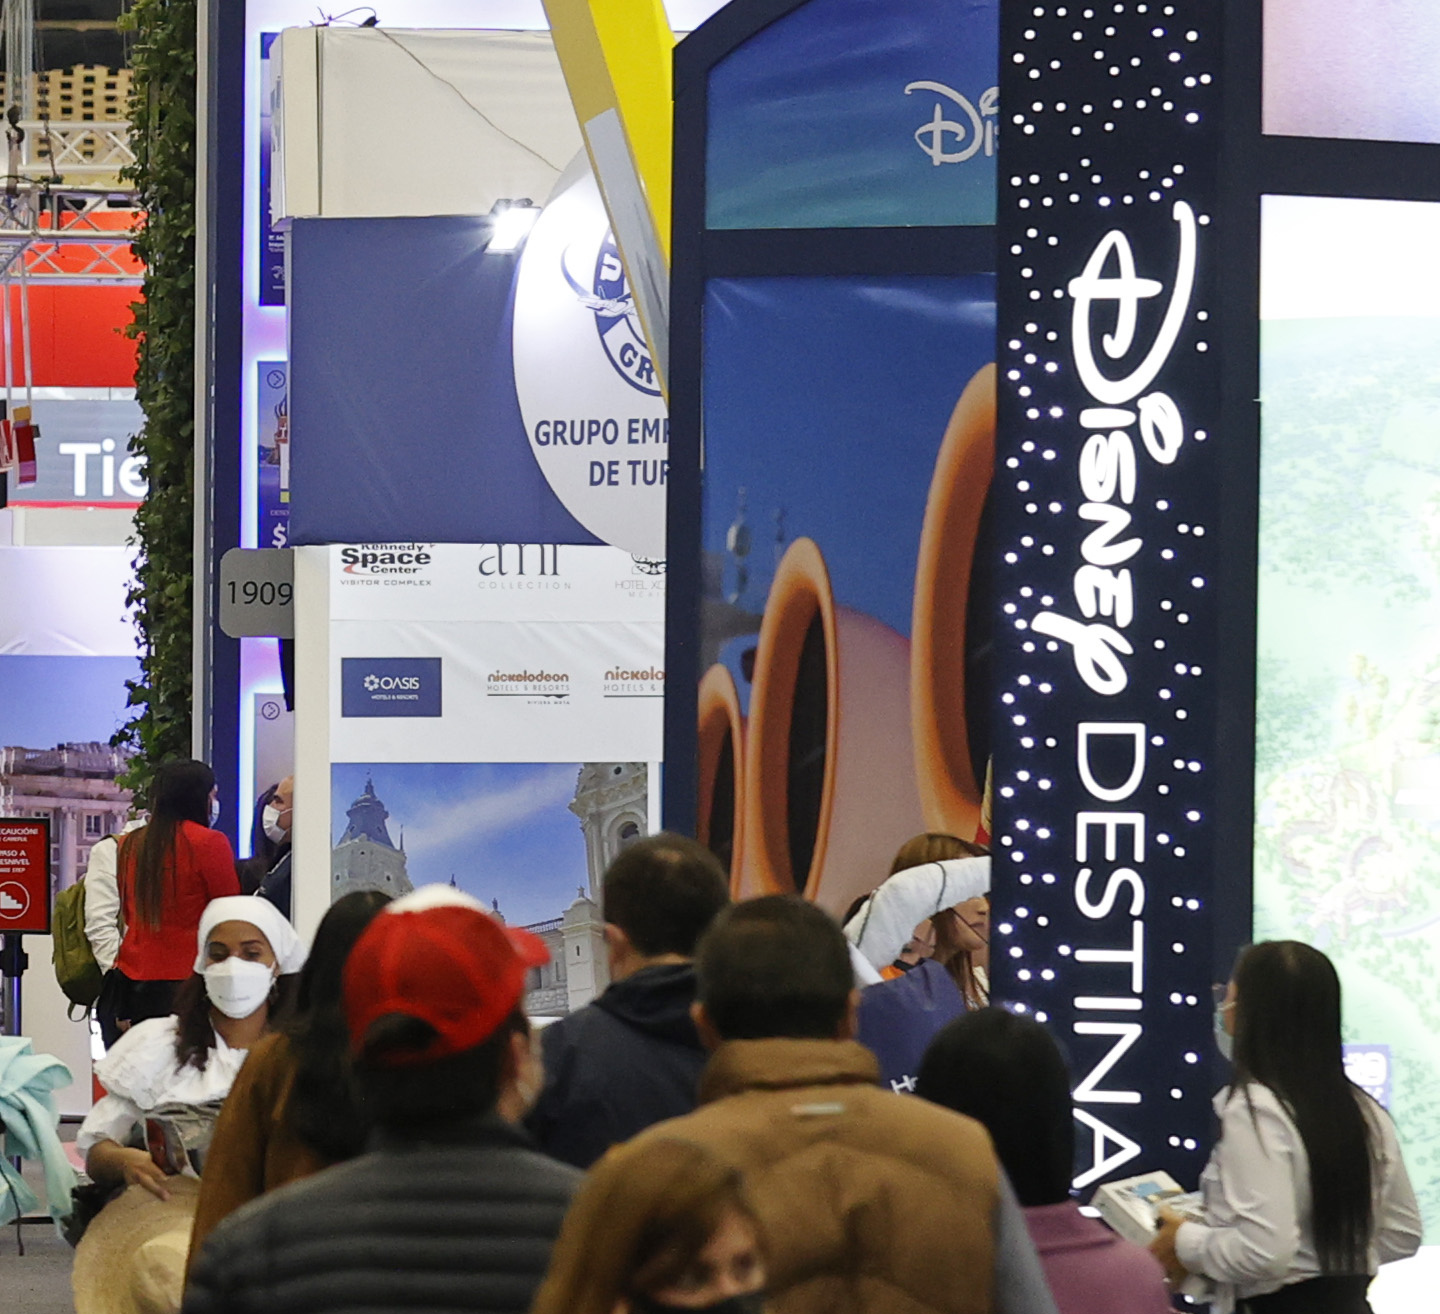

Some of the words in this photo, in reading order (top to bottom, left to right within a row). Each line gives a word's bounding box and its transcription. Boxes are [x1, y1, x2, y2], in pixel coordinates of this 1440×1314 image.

[535, 418, 619, 447] GRUPO
[1031, 199, 1198, 697] Disney
[589, 461, 620, 487] DE
[341, 547, 431, 568] Space
[370, 565, 418, 574] Center
[227, 581, 293, 606] 1909
[478, 581, 571, 590] COLLECTION
[380, 677, 420, 690] OASIS
[488, 670, 569, 682] nickelodeon
[603, 684, 644, 692] HOTELS
[1072, 722, 1146, 1217] DESTINA
